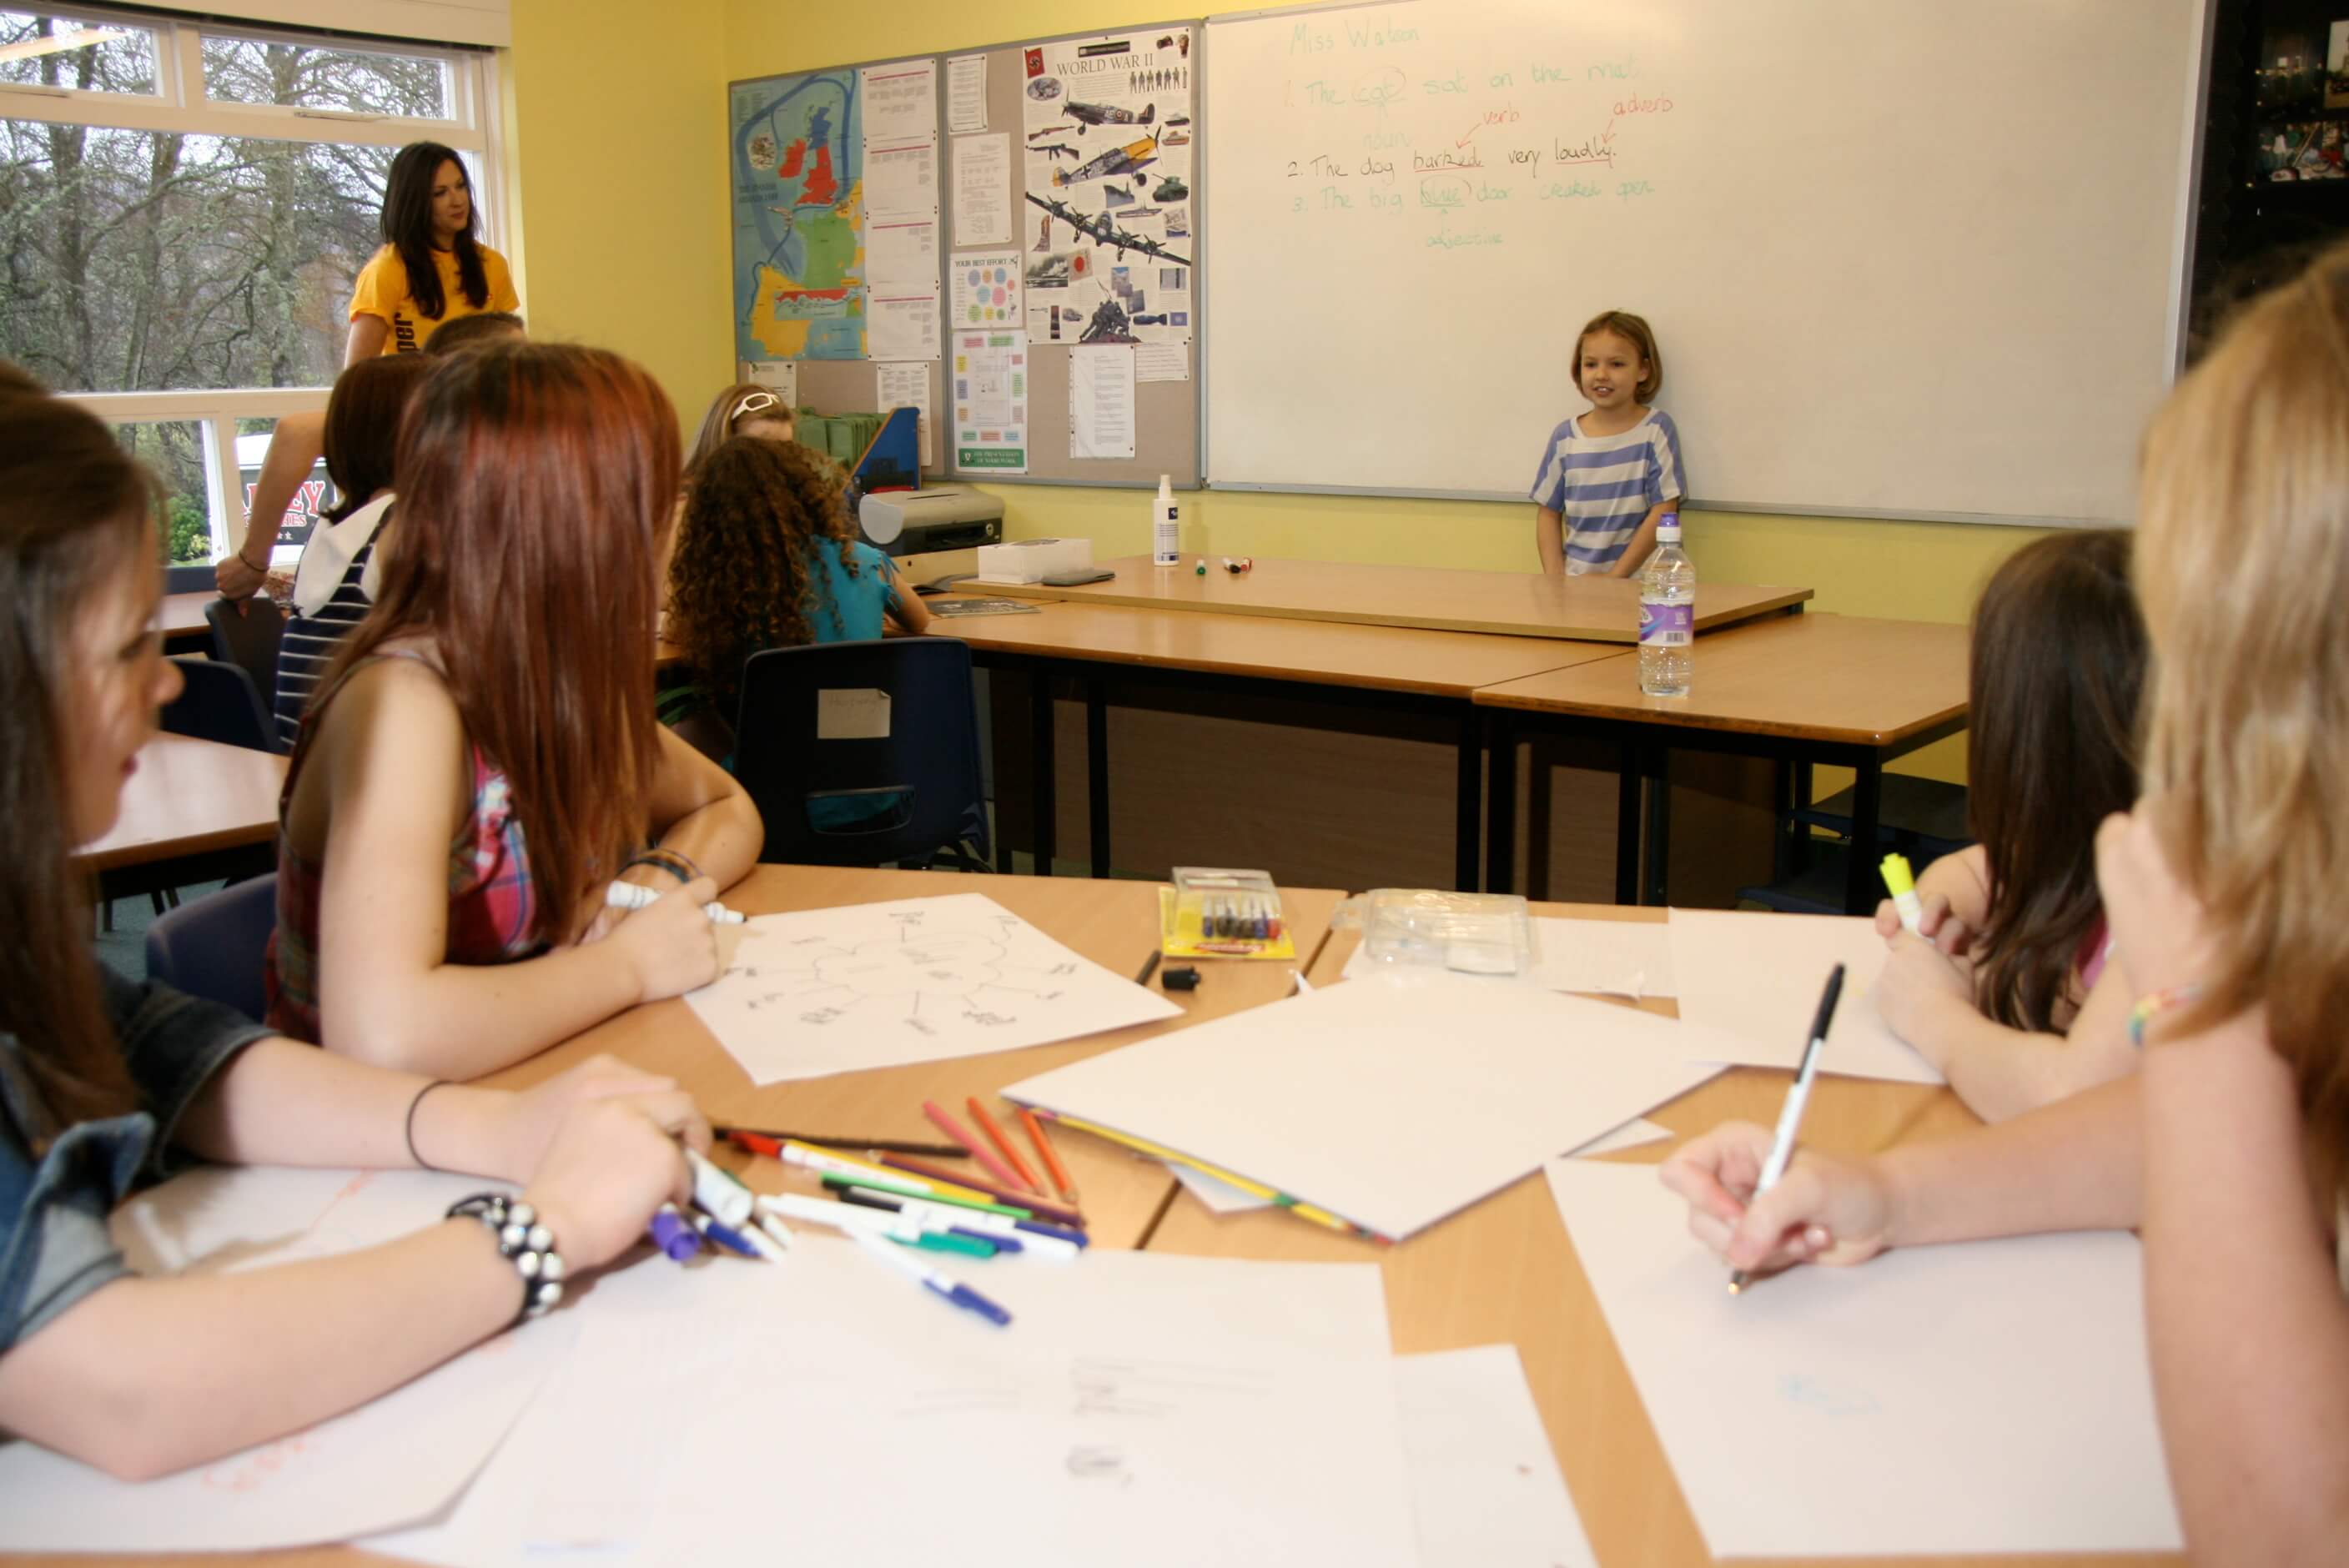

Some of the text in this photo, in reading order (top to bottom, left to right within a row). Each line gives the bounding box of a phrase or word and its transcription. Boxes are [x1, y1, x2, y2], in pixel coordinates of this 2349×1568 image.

[1290, 15, 1420, 56] Miss Watson
[1057, 53, 1154, 77] WORLD WAR II
[1305, 79, 1346, 105] The
[1422, 67, 1468, 94] sat
[1489, 72, 1514, 88] on
[1531, 63, 1572, 83] the
[1482, 101, 1520, 126] verb
[1612, 91, 1674, 117] adverb
[1362, 131, 1410, 148] noun
[1287, 135, 1618, 185] 2. The dog barked very loudly.
[1291, 195, 1309, 214] 3.
[1320, 185, 1355, 209] The
[1369, 185, 1405, 216] big
[1476, 180, 1514, 203] door
[1426, 226, 1506, 249] adjective
